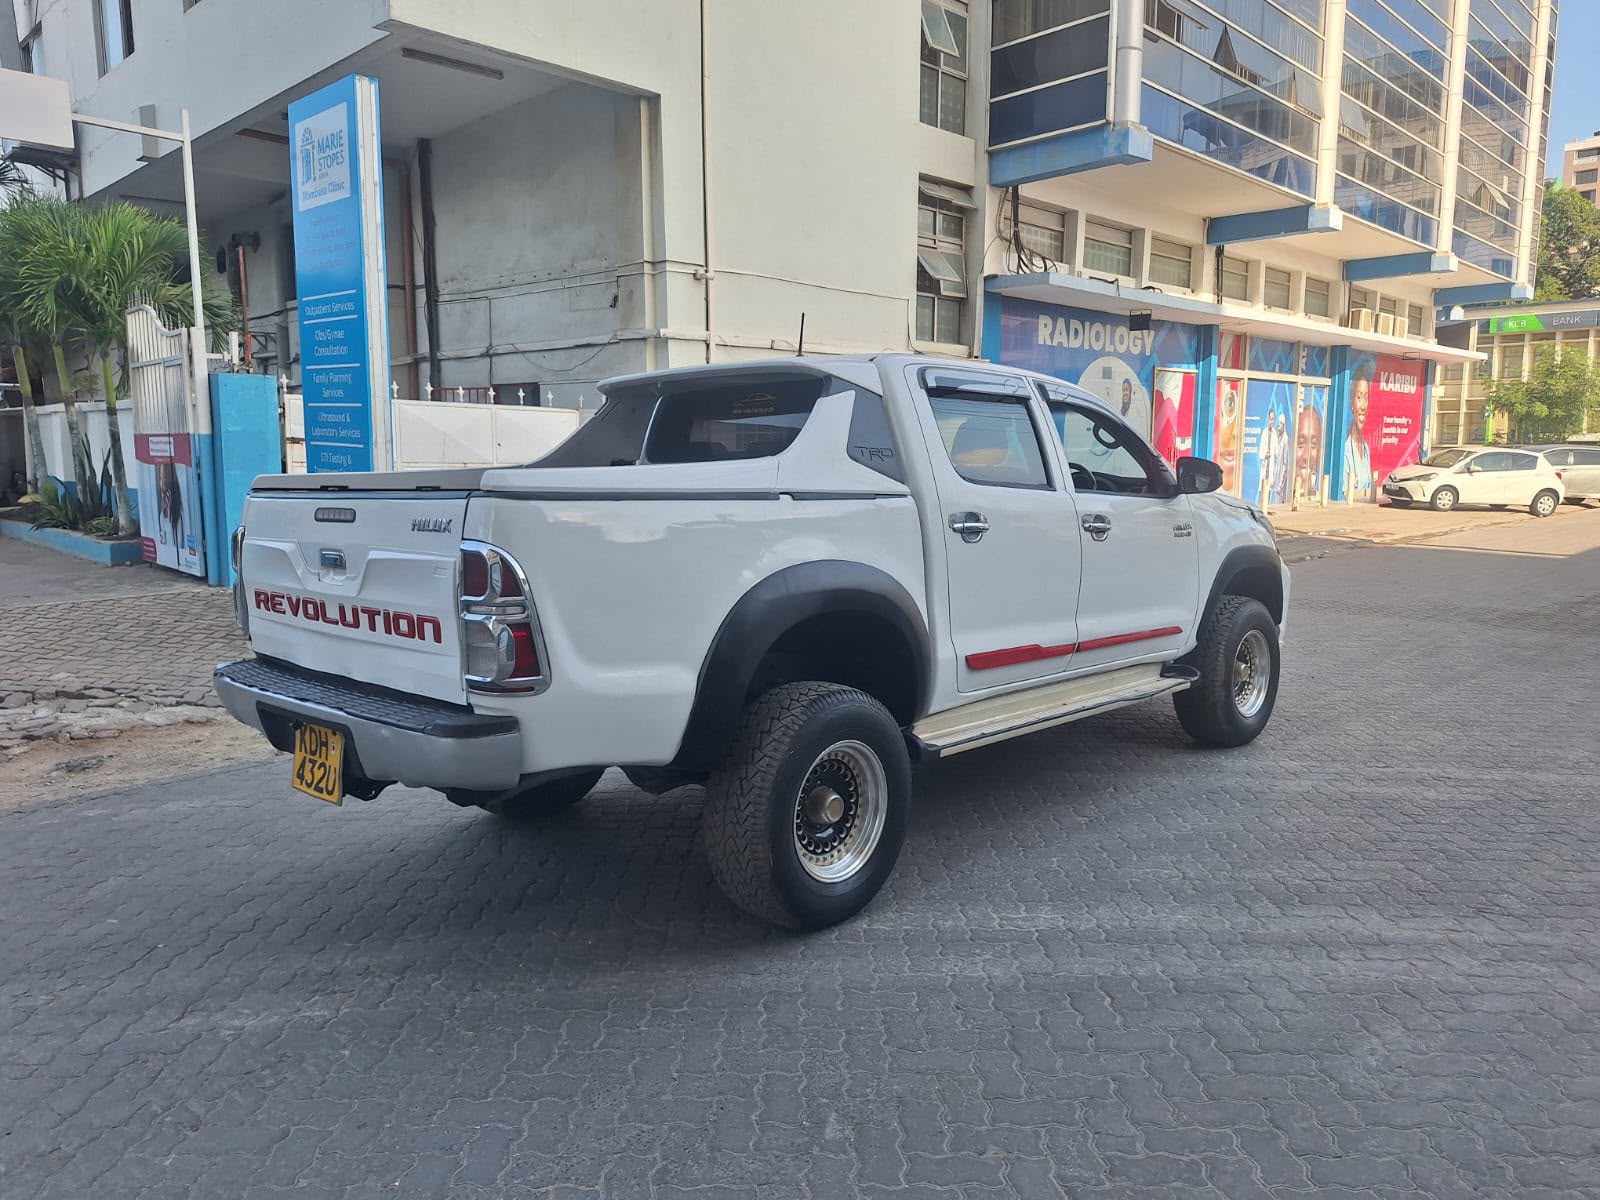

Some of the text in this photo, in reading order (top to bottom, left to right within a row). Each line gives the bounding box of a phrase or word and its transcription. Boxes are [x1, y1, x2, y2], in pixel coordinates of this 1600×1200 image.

[317, 130, 344, 154] MARIE
[318, 150, 345, 172] STOPES
[305, 301, 355, 316] Outpatient Services
[1508, 315, 1581, 329] KCB BANK
[1038, 314, 1155, 356] RADIOLOGY
[314, 344, 349, 356] Consultation
[313, 372, 352, 385] Family Planning
[1380, 371, 1417, 395] KARIBU
[322, 387, 344, 398] Services
[339, 427, 361, 438] Services
[853, 446, 895, 462] TRD
[411, 518, 453, 533] HILUX
[254, 588, 442, 644] REVOLUTION
[299, 724, 328, 761] KDH
[297, 756, 337, 796] 432U
